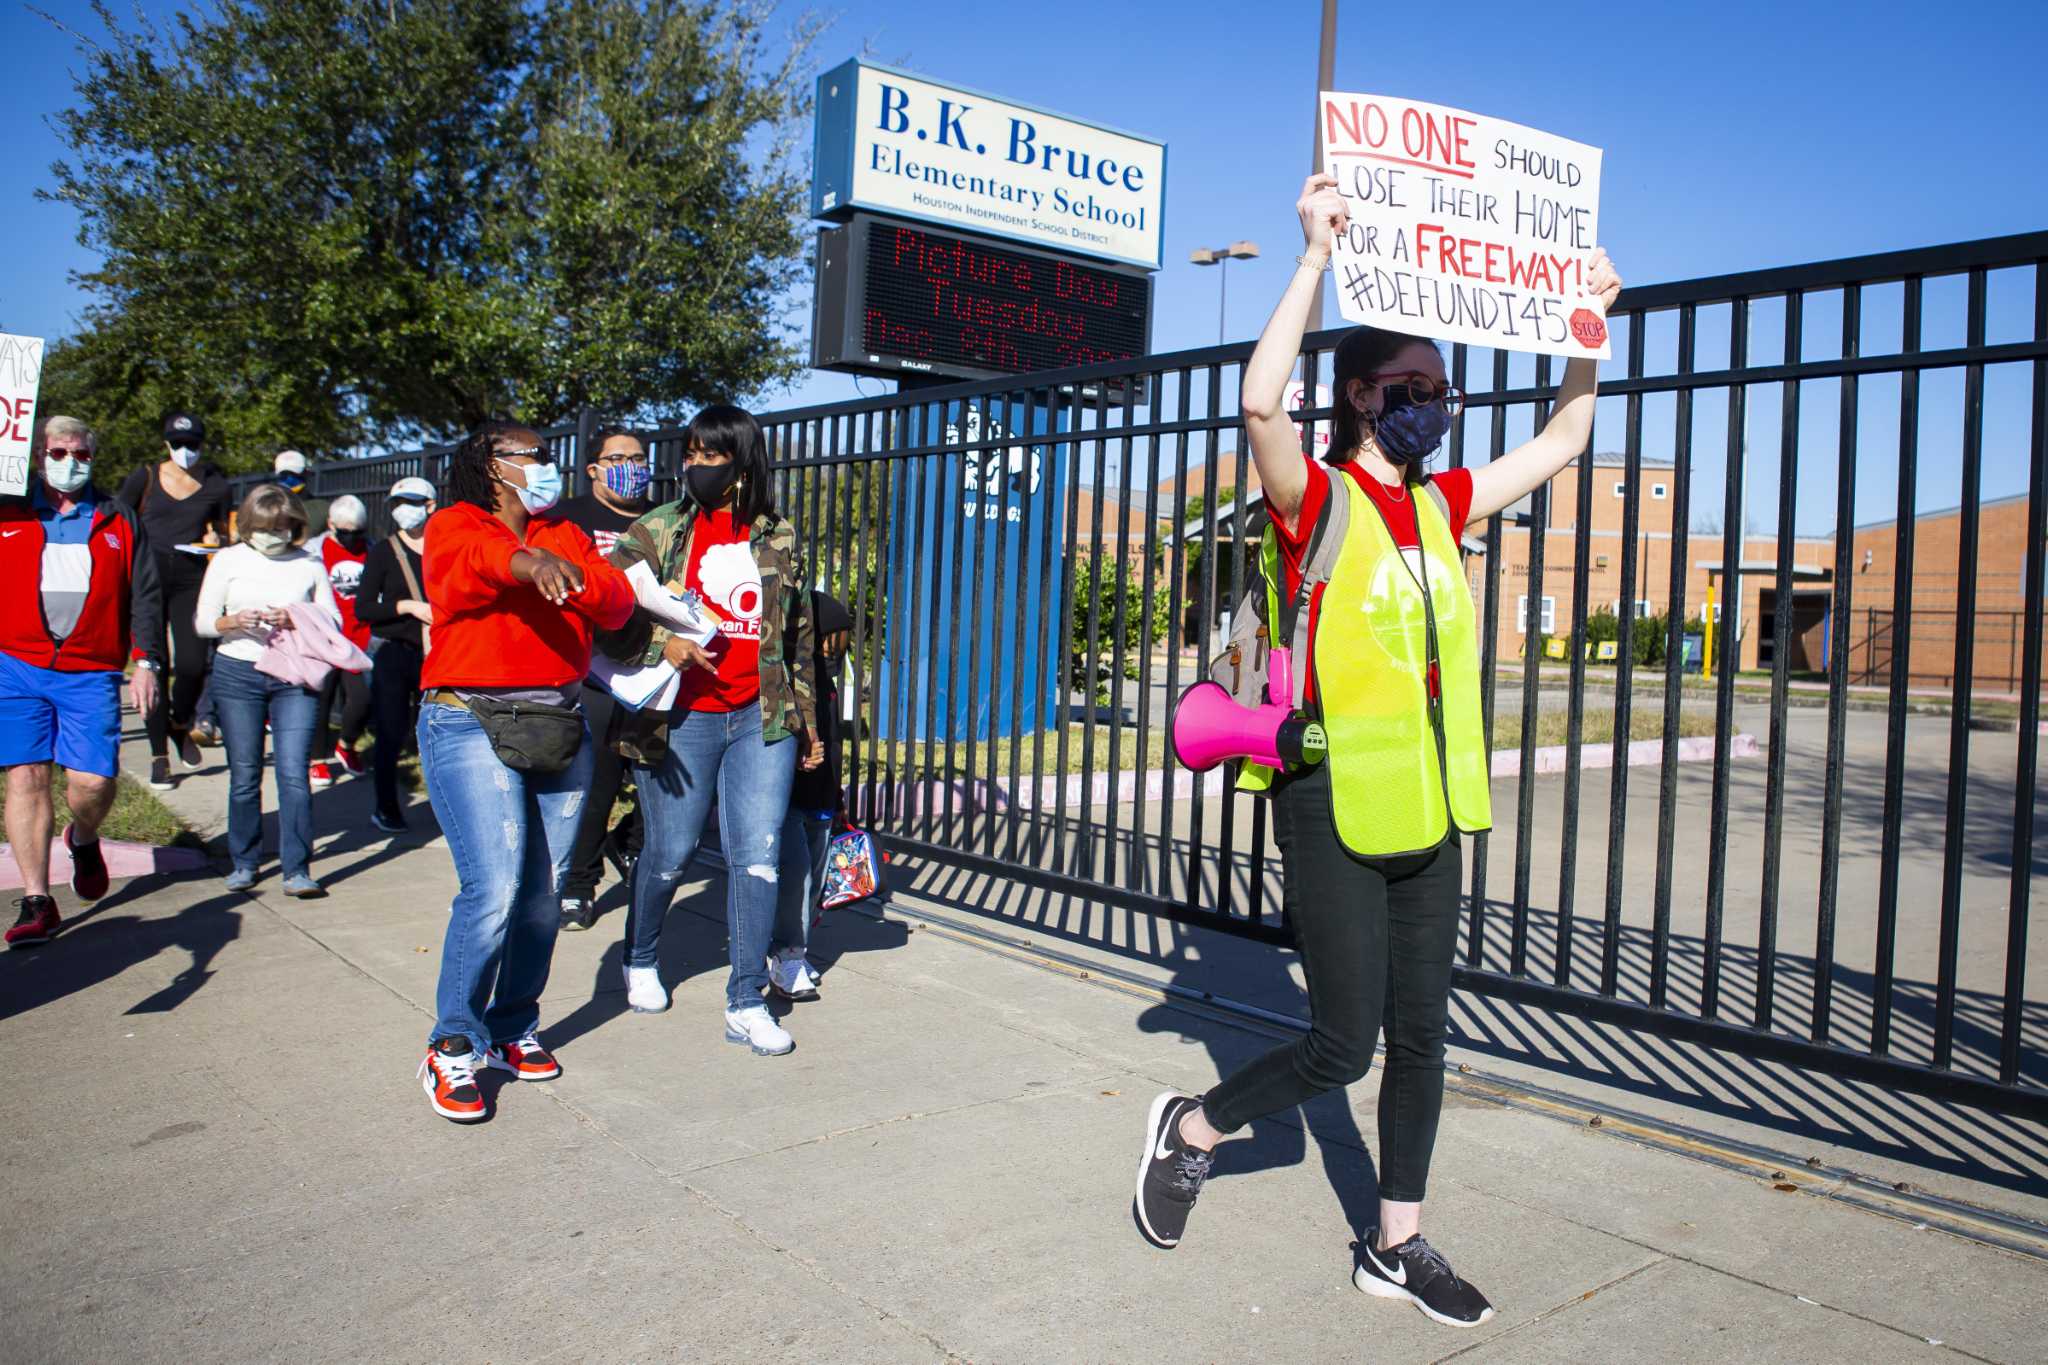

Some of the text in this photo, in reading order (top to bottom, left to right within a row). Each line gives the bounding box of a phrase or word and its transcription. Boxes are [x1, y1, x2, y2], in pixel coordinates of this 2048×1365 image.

[876, 83, 1145, 192] B.K. Bruce
[1325, 101, 1581, 187] NO ONE SHOULD
[871, 142, 1145, 231] Elementary School
[913, 192, 1109, 245] HOUSTON INDEPENDENT SCHOOL DISTRICT
[1333, 164, 1592, 249] LOSE THEIR HOME
[895, 227, 1119, 307] Picture Day
[1393, 227, 1409, 262] A
[1416, 223, 1584, 298] FREEWAY!
[866, 308, 935, 357] Dec
[928, 277, 1086, 341] Tuesday
[1573, 321, 1604, 337] STOP
